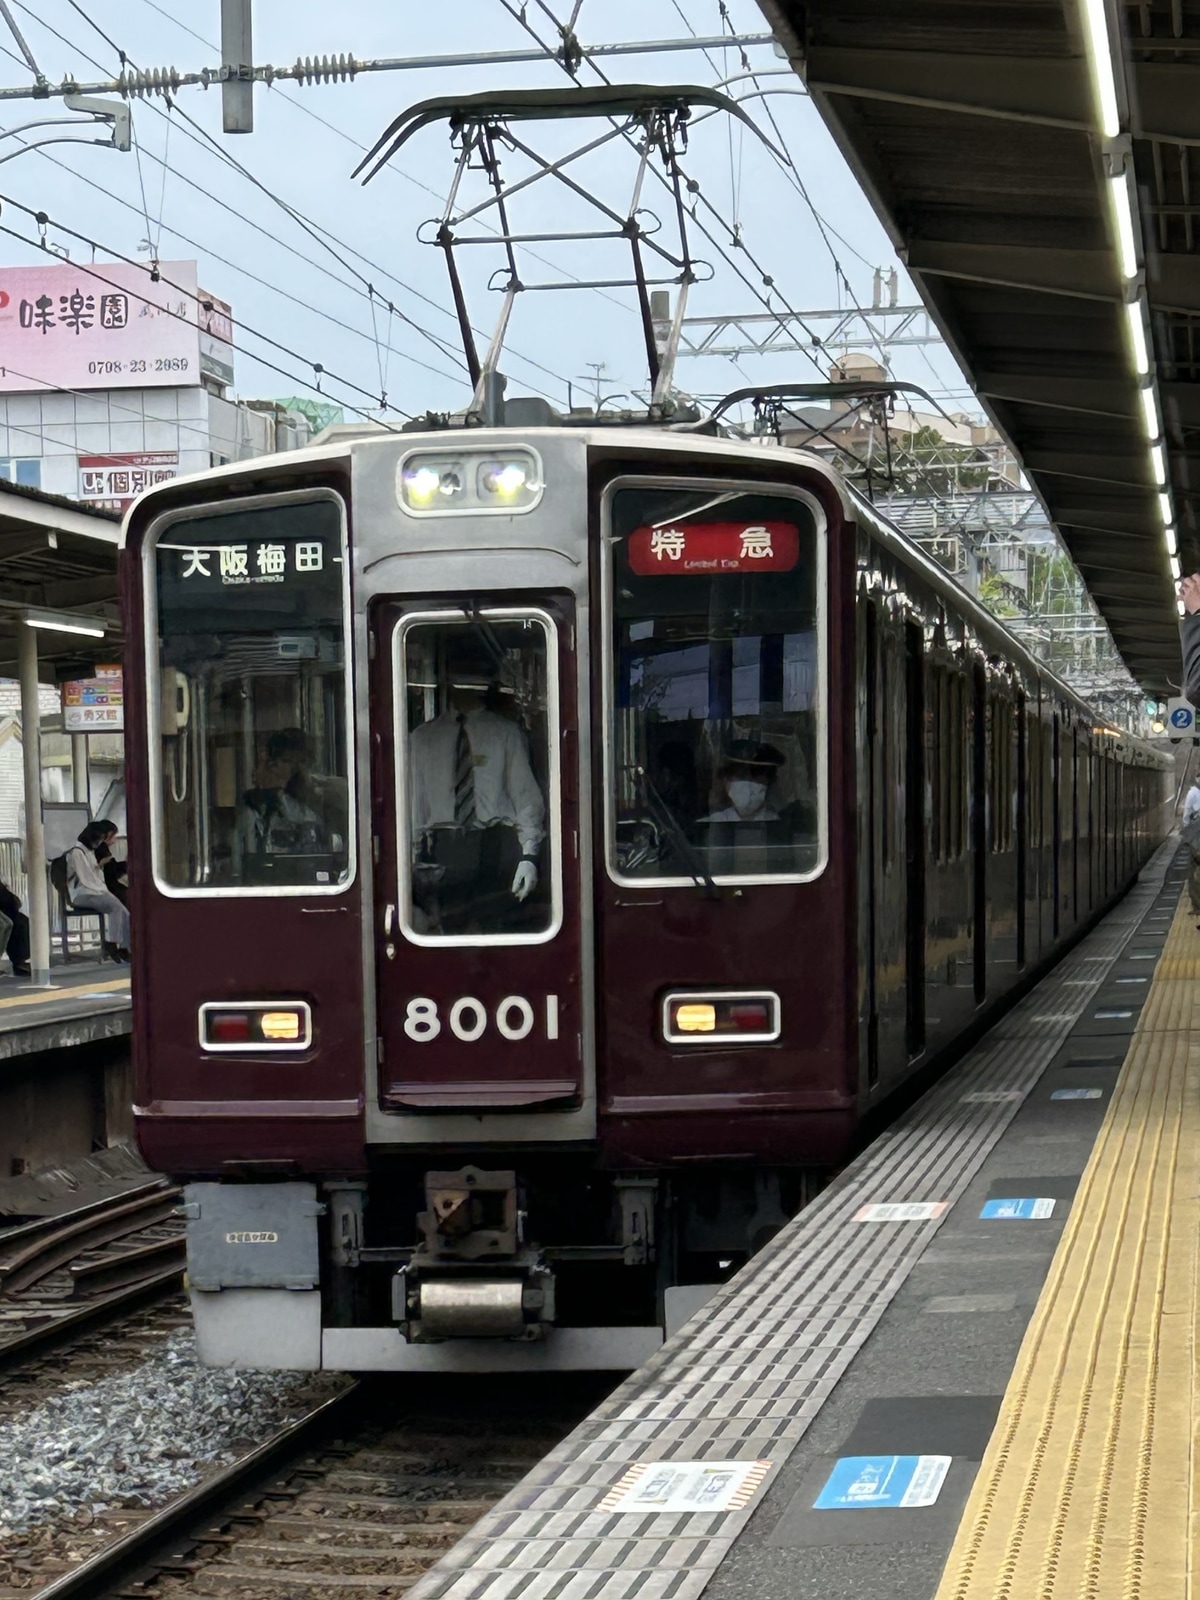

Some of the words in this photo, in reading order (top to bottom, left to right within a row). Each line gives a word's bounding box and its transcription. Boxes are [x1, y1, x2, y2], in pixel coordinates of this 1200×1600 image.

[19, 288, 129, 335] 味楽園
[182, 542, 323, 578] 大阪梅田
[651, 526, 774, 561] 特急
[1176, 709, 1189, 727] 2
[404, 995, 558, 1042] 8001
